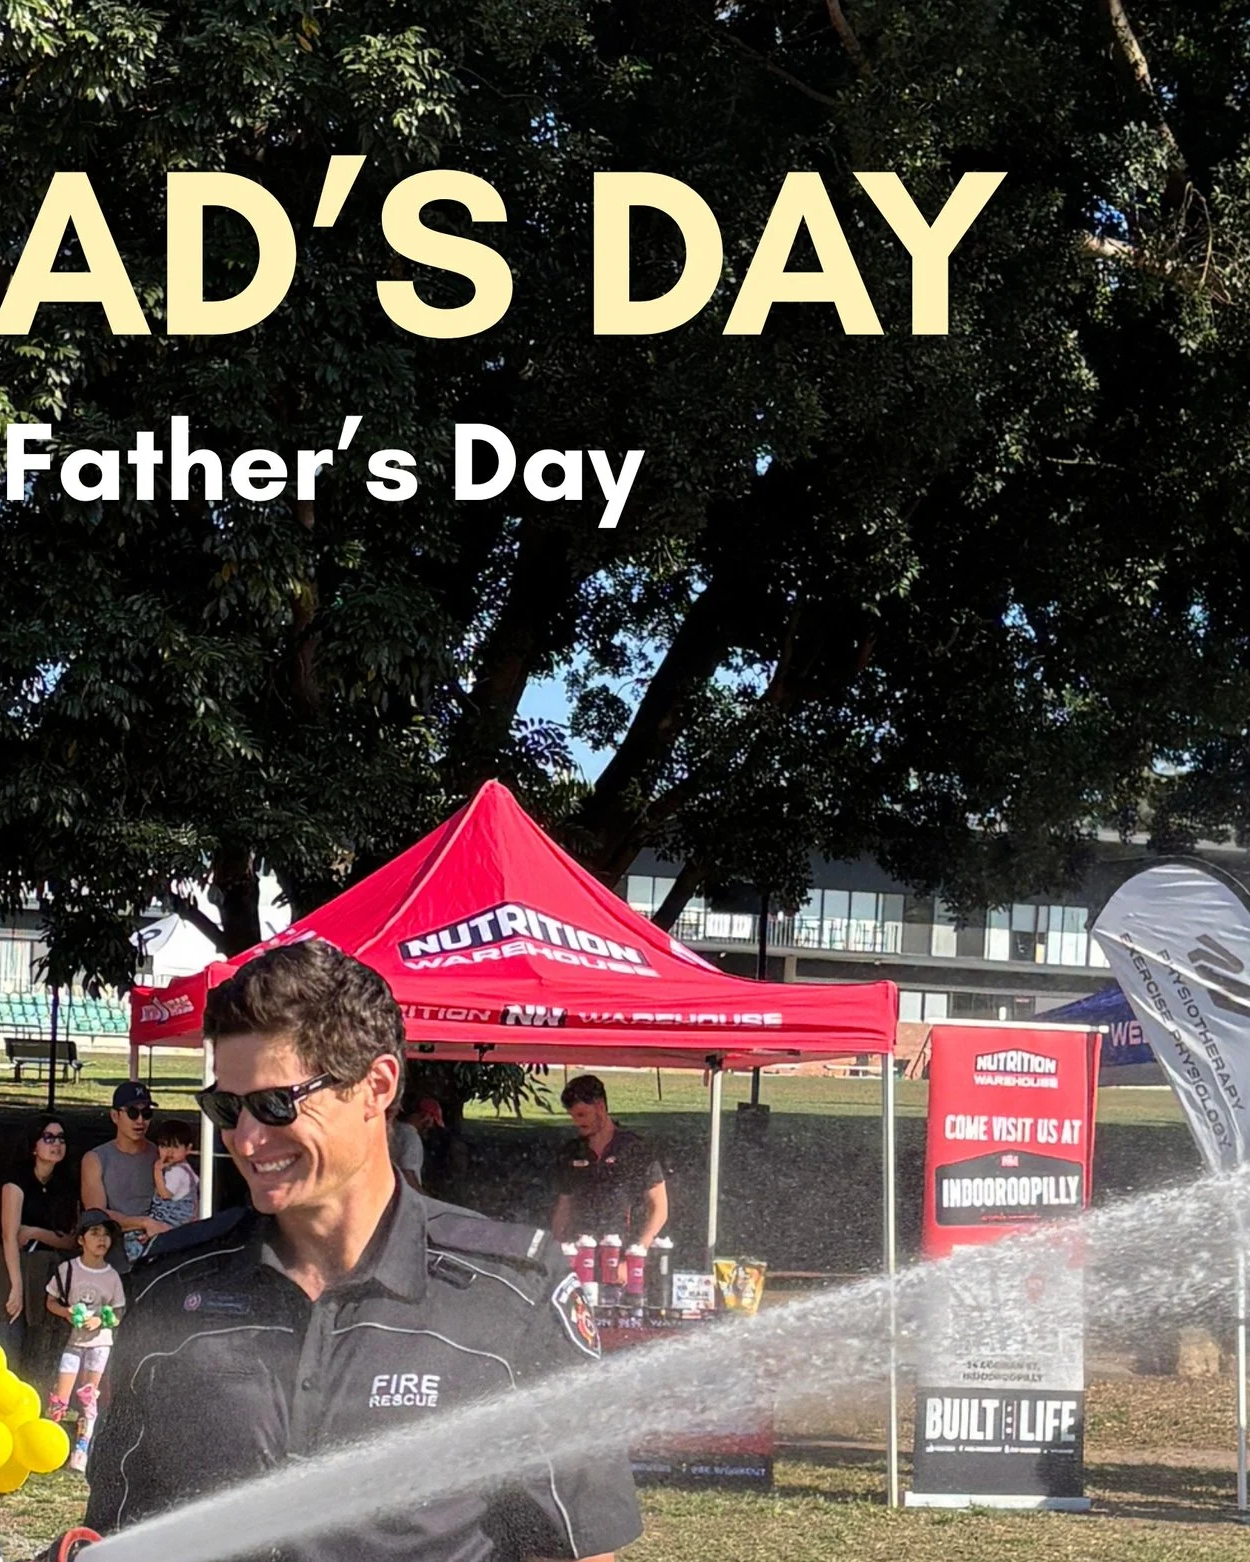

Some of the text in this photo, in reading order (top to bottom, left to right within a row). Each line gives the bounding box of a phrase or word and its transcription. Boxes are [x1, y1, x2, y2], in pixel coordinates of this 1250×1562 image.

[404, 903, 643, 964] NUTRITION
[403, 940, 662, 978] WAREHOUSE
[1156, 948, 1245, 1111] PHYSIOTHERAPY
[976, 1049, 1057, 1074] NUTRITION
[973, 1073, 1059, 1089] WAREHOUSE
[1169, 1028, 1232, 1149] PHYSIOLOGY
[944, 1114, 1082, 1145] COME VISIT US AT
[942, 1175, 1080, 1208] INDOOROOPILLY
[369, 1393, 438, 1408] RESCUE
[371, 1373, 441, 1395] FIRE
[925, 1397, 1000, 1441] BUILT
[1019, 1399, 1077, 1442] LIFE
